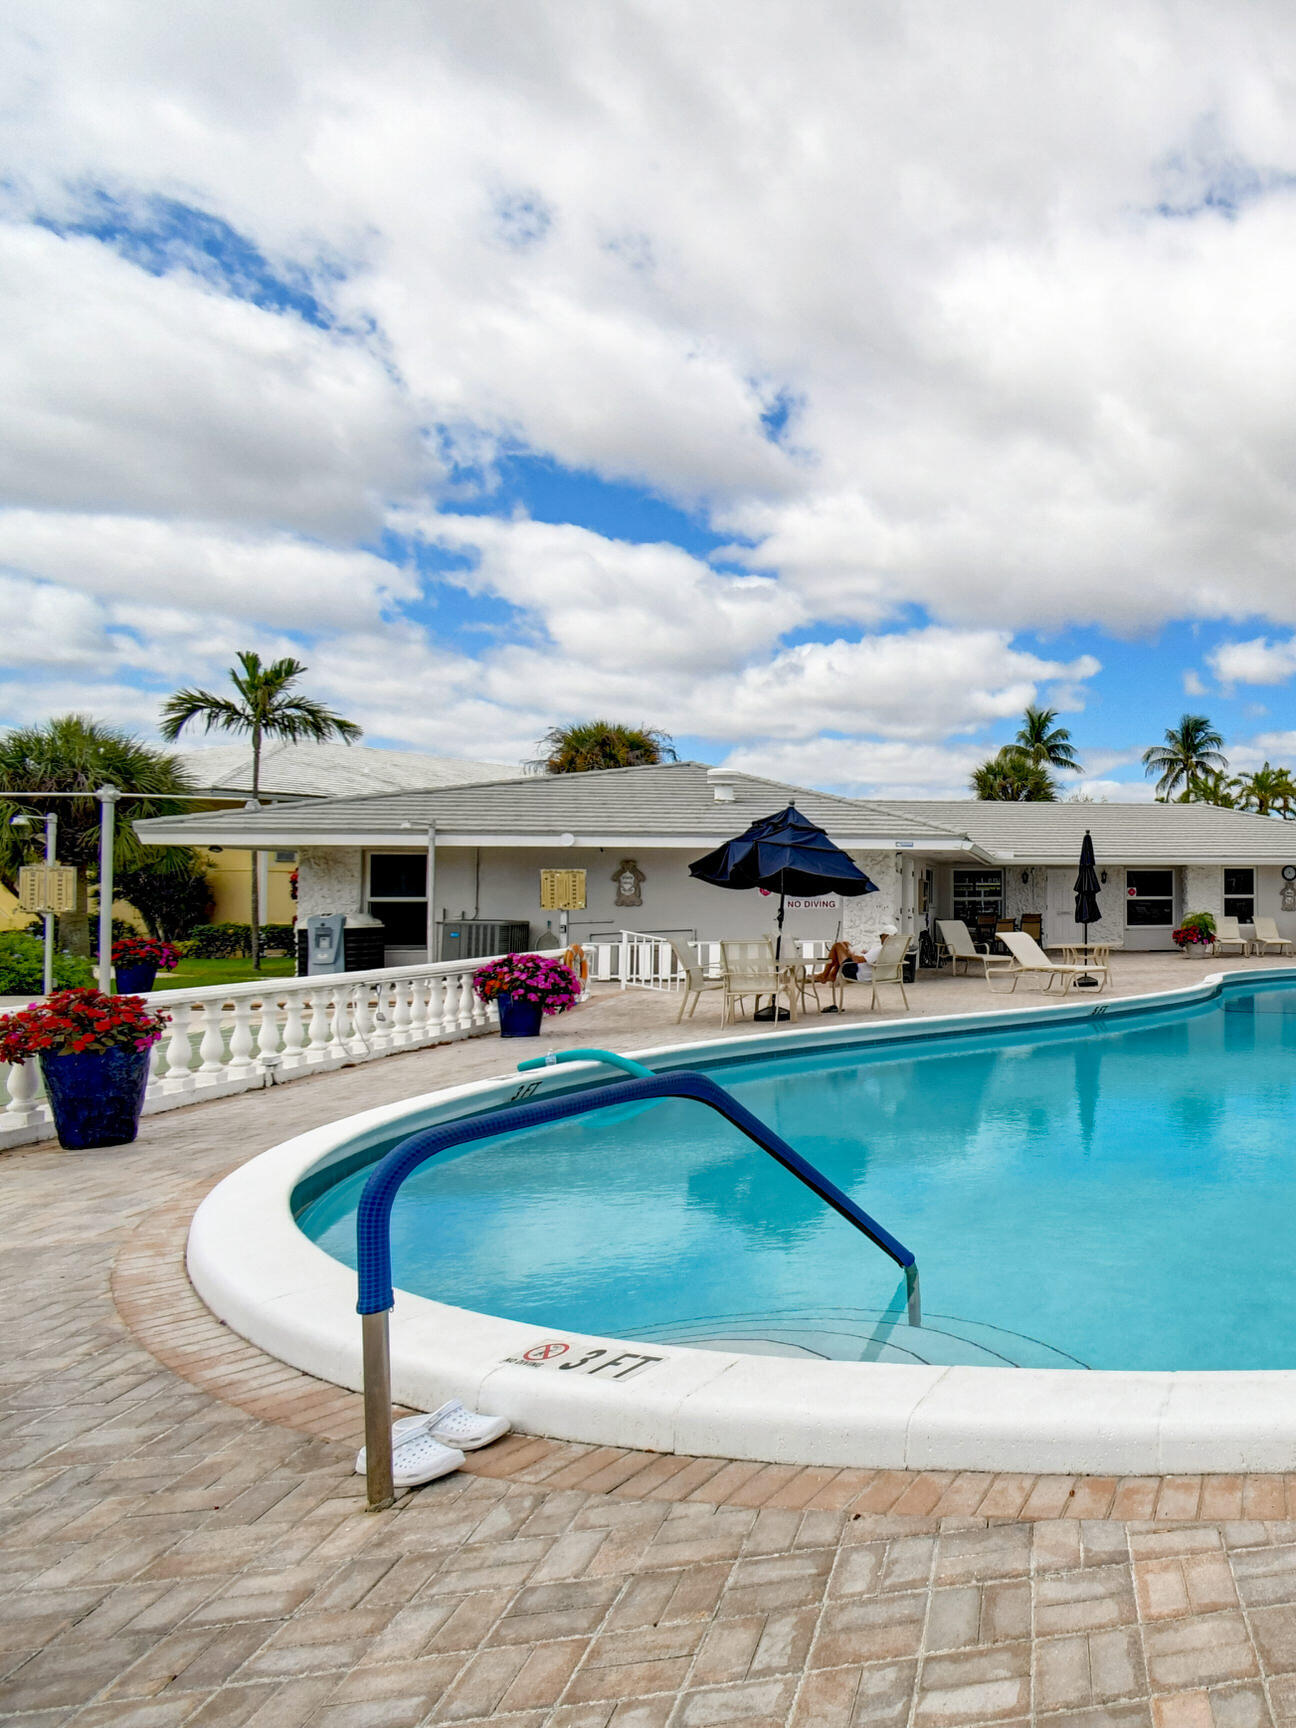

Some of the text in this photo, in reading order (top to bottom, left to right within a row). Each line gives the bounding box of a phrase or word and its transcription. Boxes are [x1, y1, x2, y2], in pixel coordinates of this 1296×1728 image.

[787, 900, 836, 908] NO DIVING
[1096, 1004, 1110, 1014] FT
[521, 1081, 543, 1098] FT
[514, 1359, 545, 1368] DIVING
[558, 1349, 664, 1378] 3 FT
